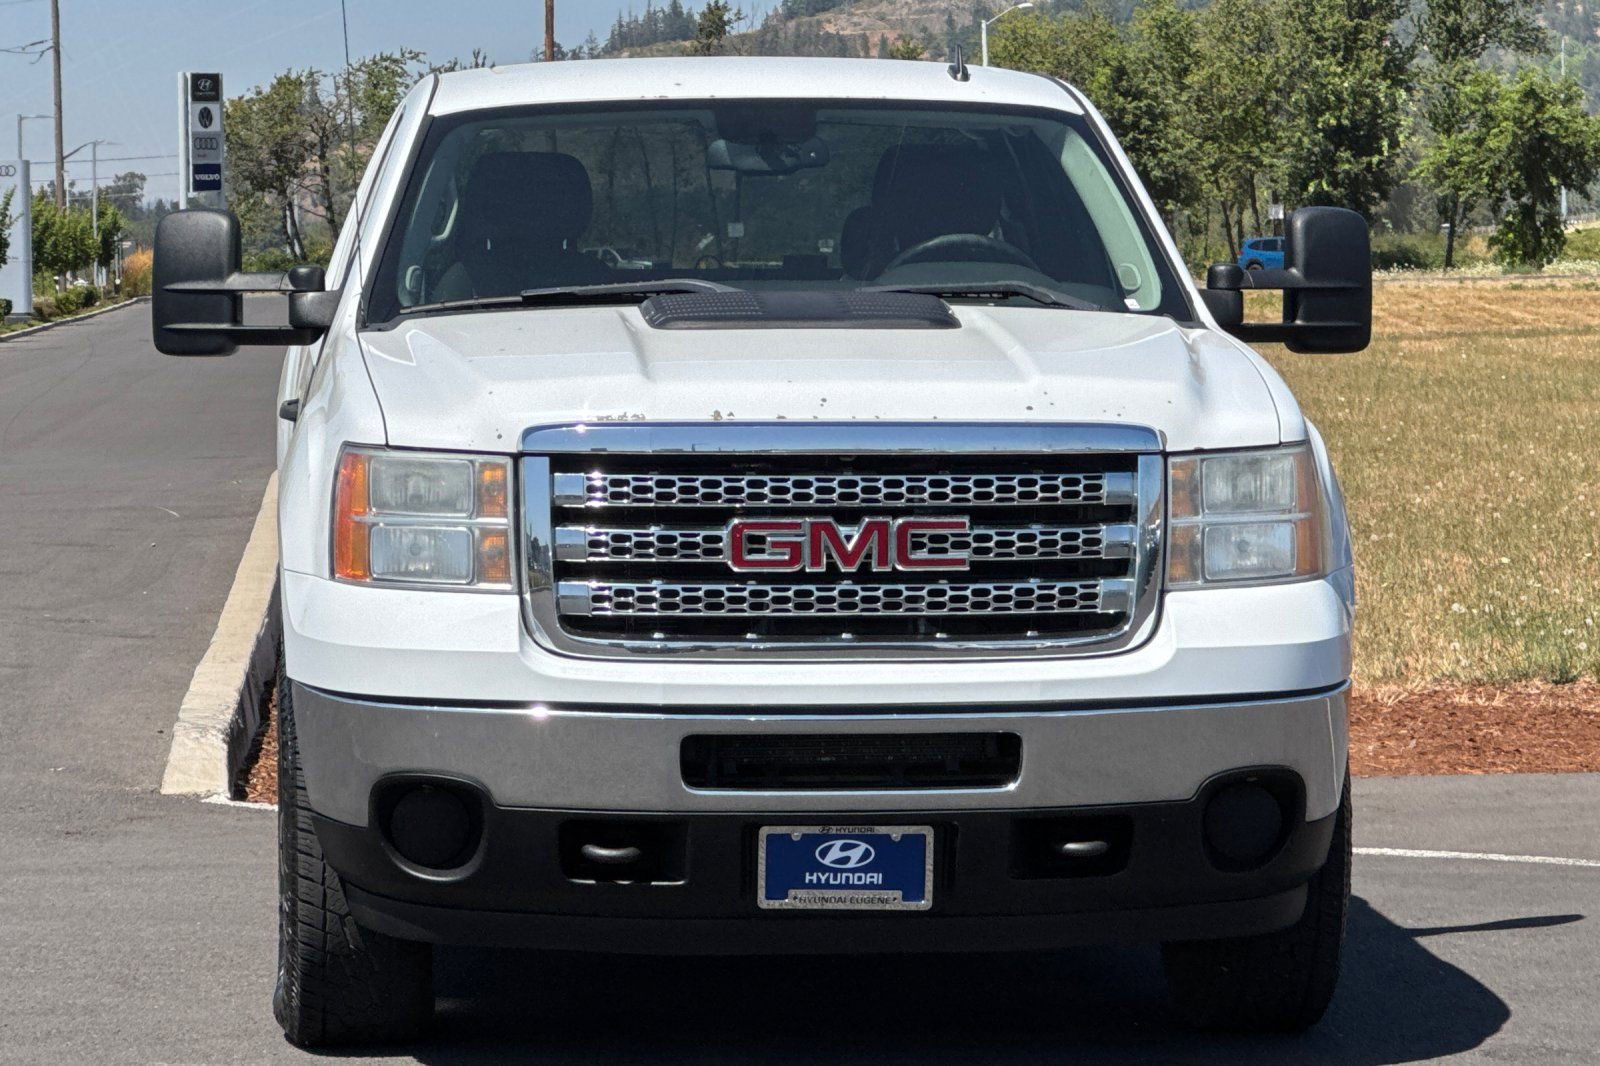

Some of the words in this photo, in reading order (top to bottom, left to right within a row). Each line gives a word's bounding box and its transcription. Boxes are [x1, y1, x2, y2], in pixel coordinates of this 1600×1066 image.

[194, 173, 220, 181] VOLVO
[726, 516, 970, 572] GMC
[805, 871, 883, 885] HYUNDAI
[799, 896, 846, 904] HYUNDAI
[849, 896, 891, 905] EUGENE
